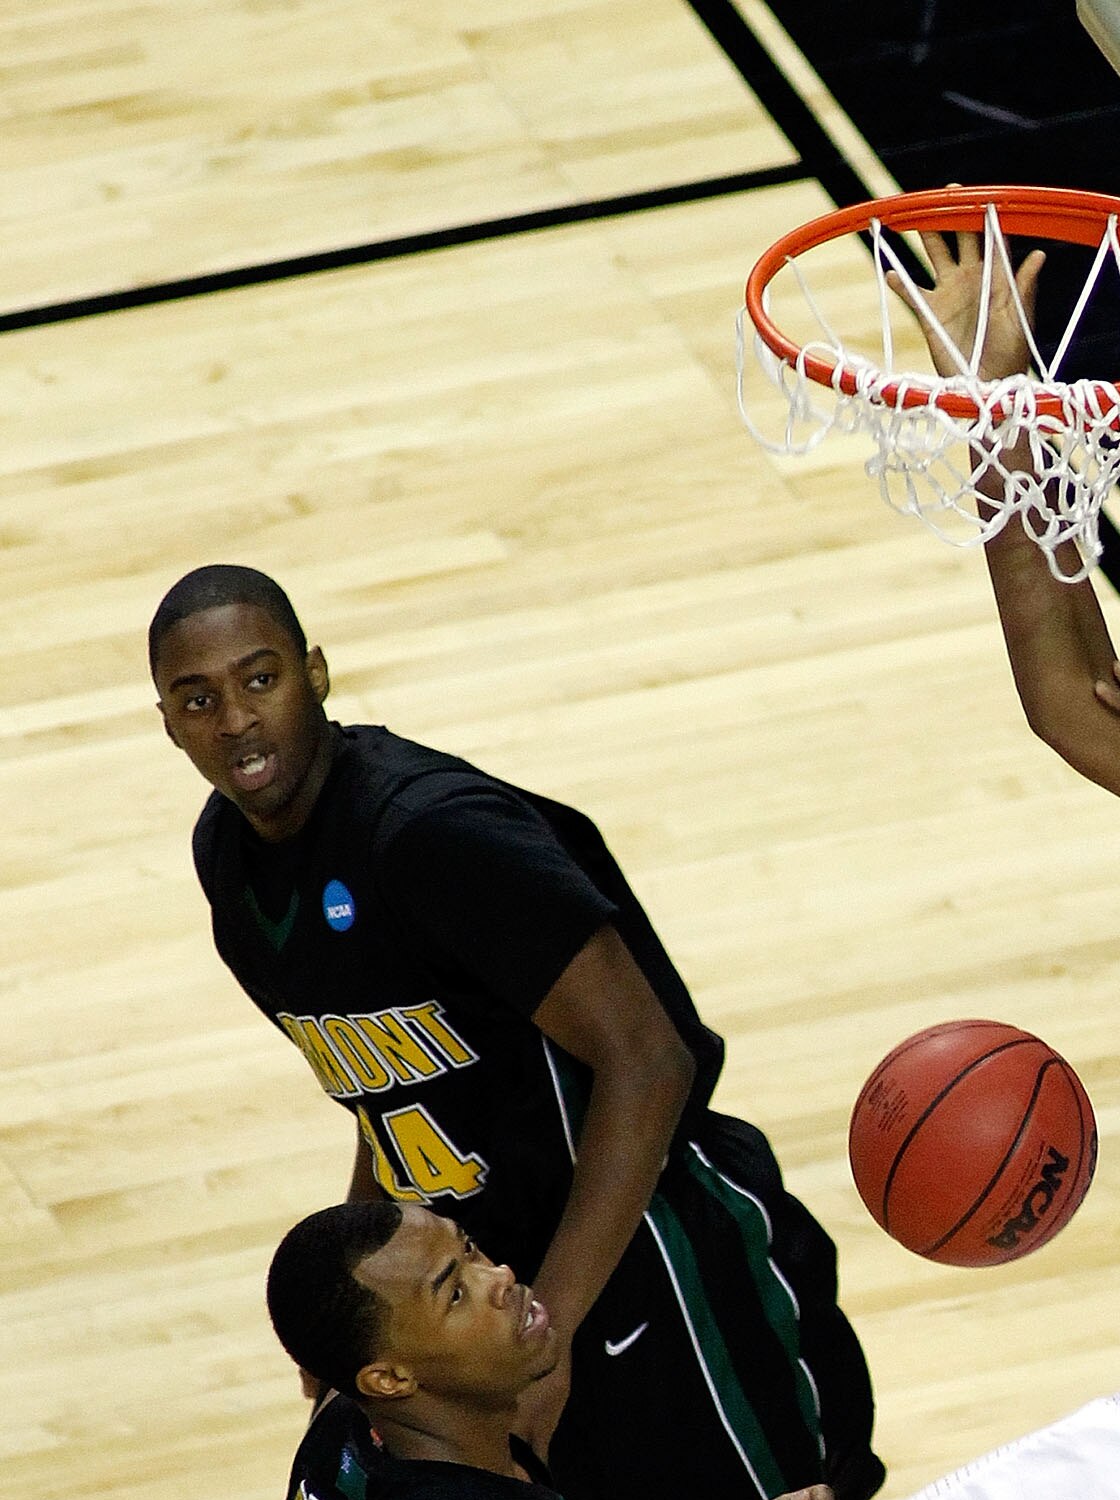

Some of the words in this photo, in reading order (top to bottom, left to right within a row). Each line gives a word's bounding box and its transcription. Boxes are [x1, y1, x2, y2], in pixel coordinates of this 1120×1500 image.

[327, 903, 352, 919] NCAA
[356, 1103, 490, 1204] 14
[986, 1145, 1070, 1250] NCAA
